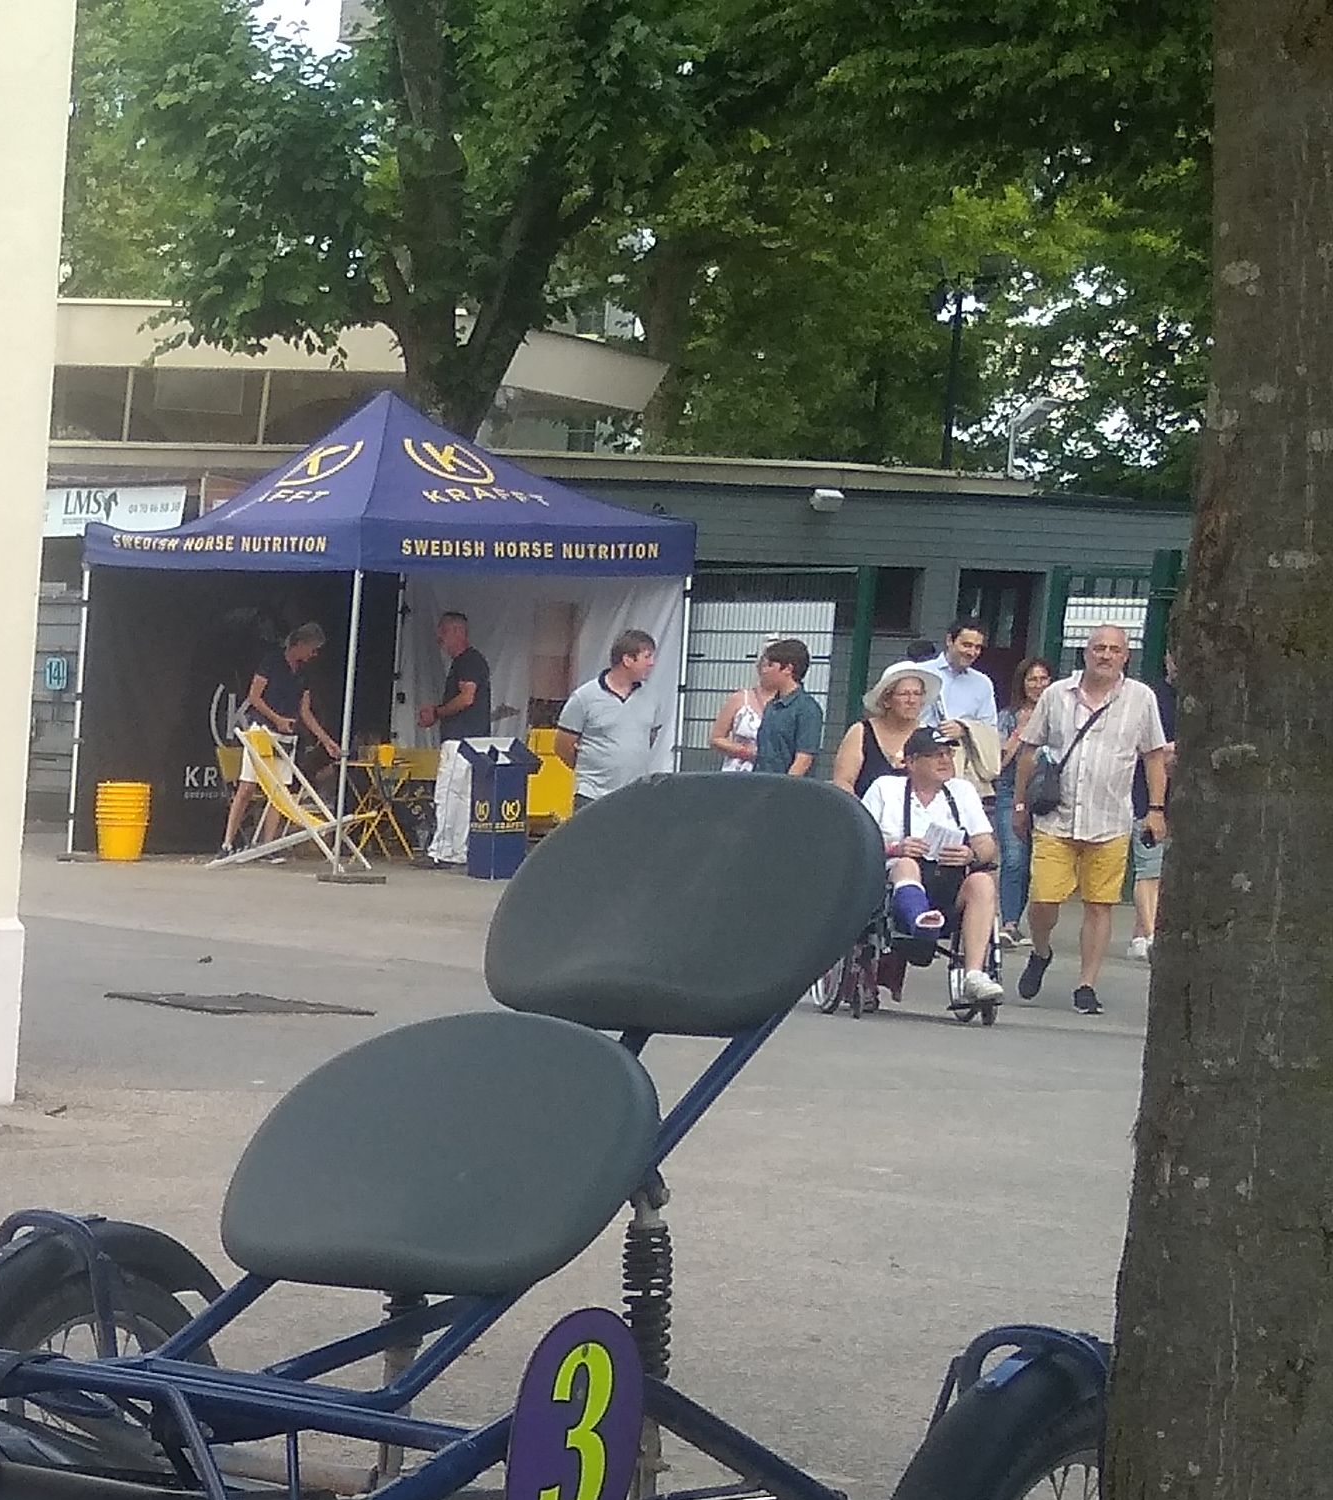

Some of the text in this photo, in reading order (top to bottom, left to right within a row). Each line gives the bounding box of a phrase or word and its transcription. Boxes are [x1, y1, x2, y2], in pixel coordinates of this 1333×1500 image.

[64, 490, 104, 515] LMS
[422, 486, 550, 507] KRAFFT
[112, 534, 327, 552] SWEDISH HORSE NUTRITION
[401, 538, 659, 560] SWEDISH HORSE NUTRITION
[47, 661, 64, 686] 14
